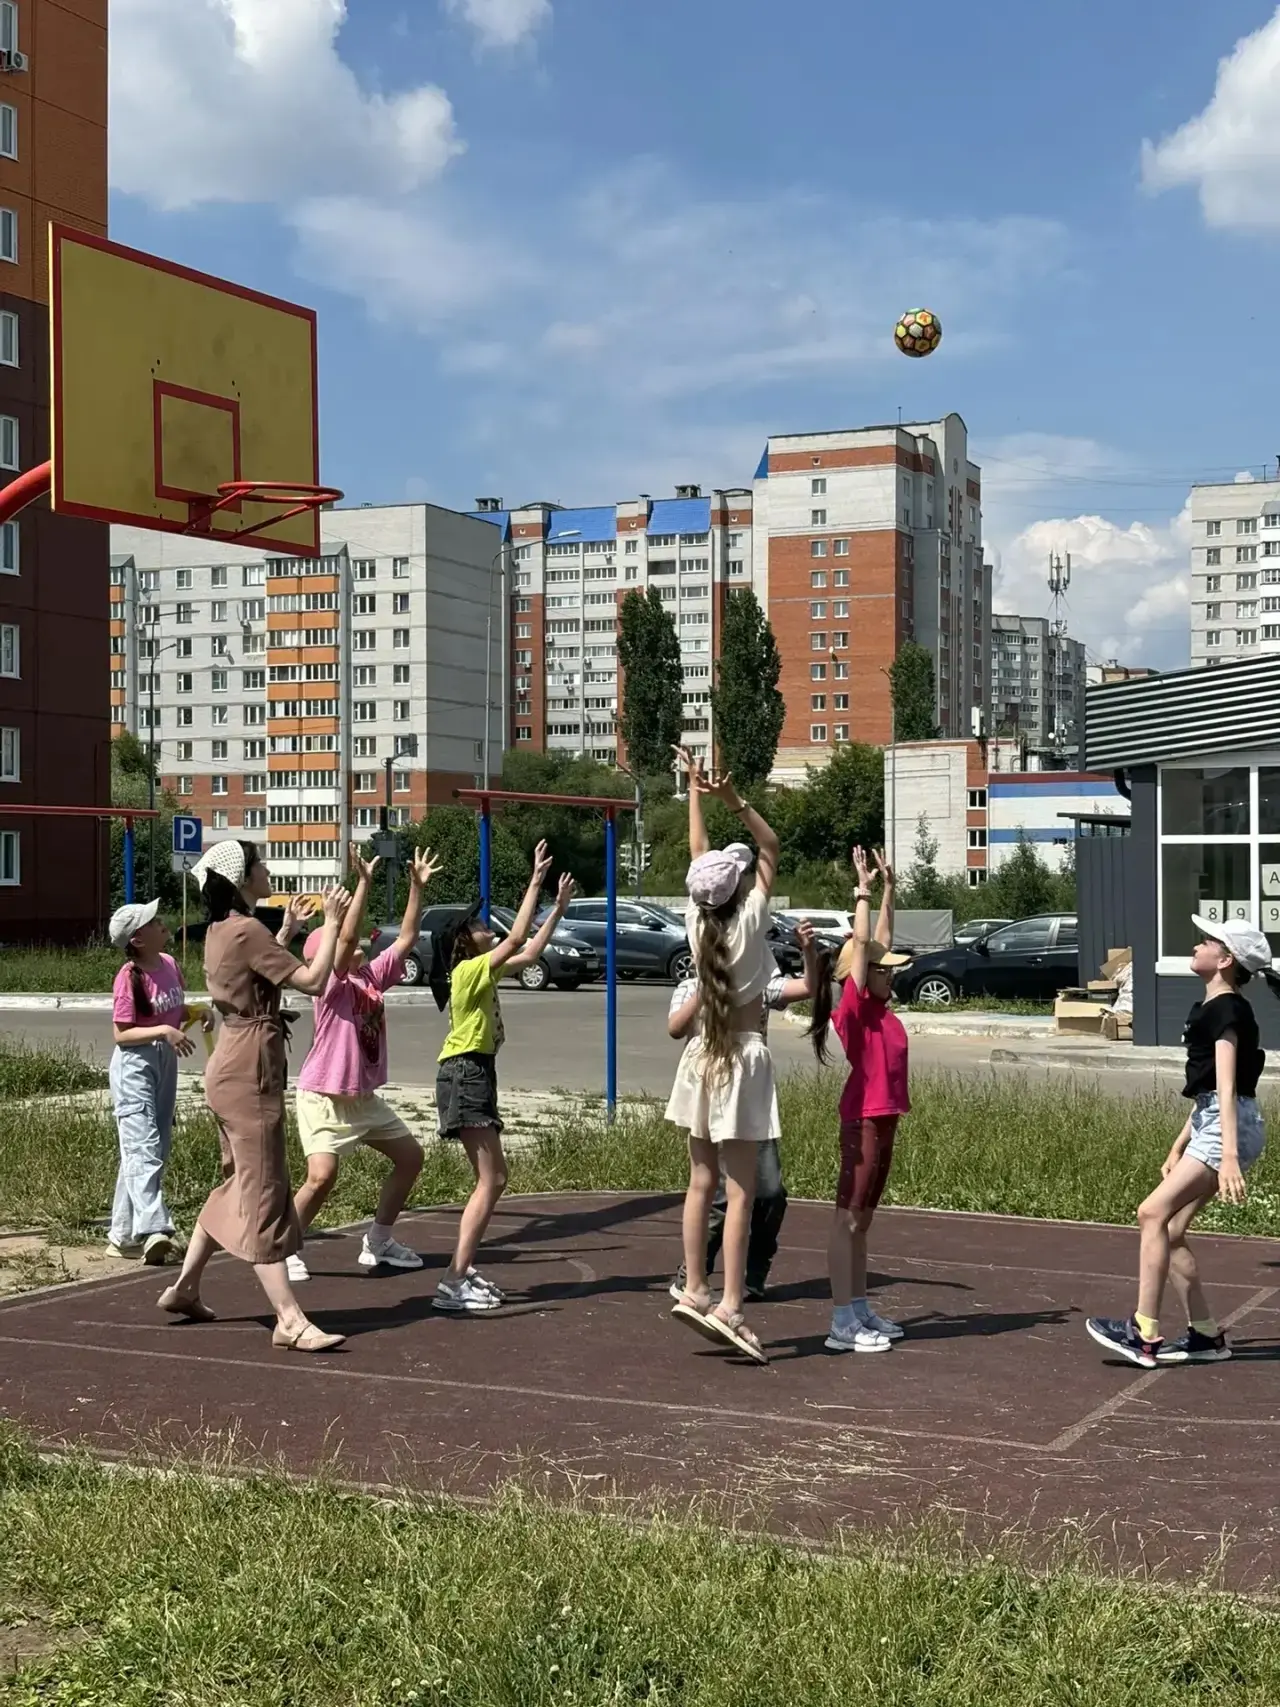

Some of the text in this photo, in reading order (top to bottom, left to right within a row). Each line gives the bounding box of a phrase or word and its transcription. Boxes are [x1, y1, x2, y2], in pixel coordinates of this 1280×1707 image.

[180, 819, 197, 849] P
[1208, 907, 1279, 921] 8 9 9
